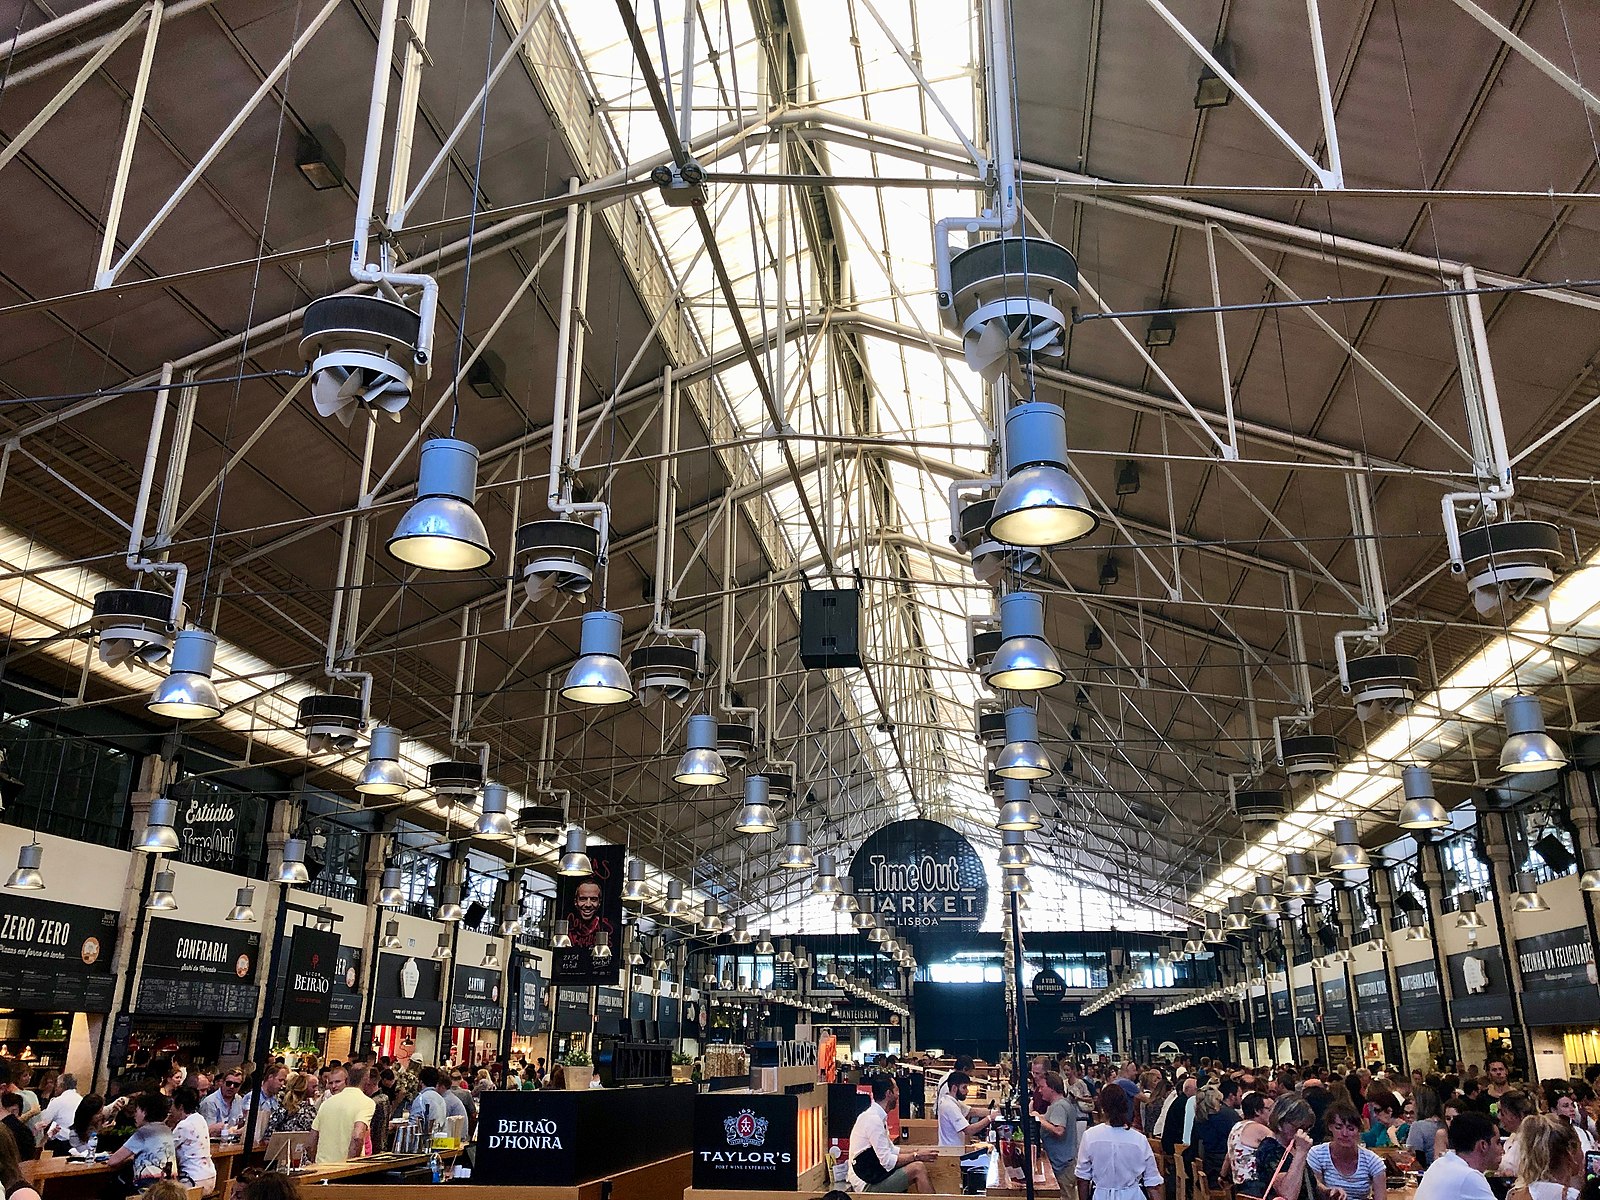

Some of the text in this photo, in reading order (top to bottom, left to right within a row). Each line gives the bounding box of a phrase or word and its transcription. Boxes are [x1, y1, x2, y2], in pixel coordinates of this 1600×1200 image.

[186, 799, 235, 824] Estúdio
[0, 914, 35, 942] ZERO
[37, 919, 71, 947] ZERO
[897, 917, 940, 926] LISBOA
[176, 937, 228, 963] CONFRARIA
[294, 973, 329, 994] BEIRÃO
[497, 1118, 557, 1135] BEIRÃO
[488, 1135, 563, 1150] D'HONRA
[700, 1151, 792, 1165] TAYLOR'S
